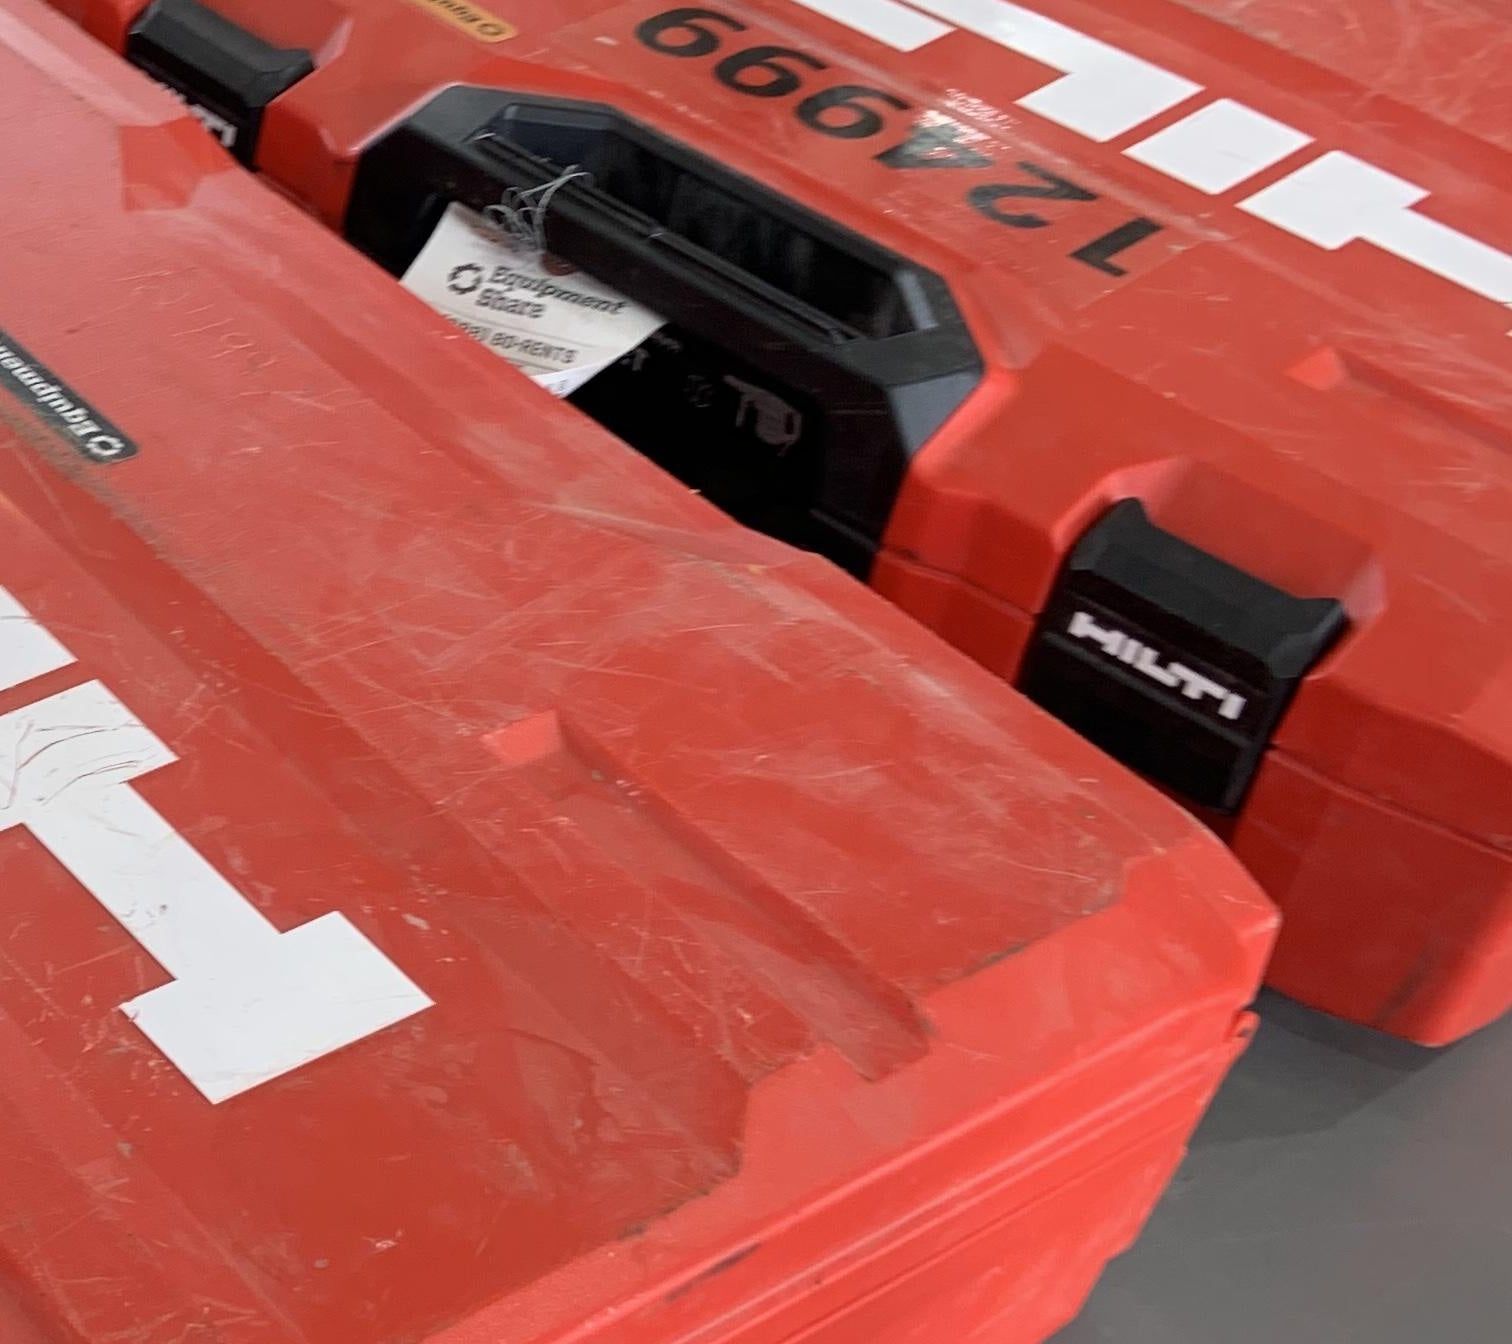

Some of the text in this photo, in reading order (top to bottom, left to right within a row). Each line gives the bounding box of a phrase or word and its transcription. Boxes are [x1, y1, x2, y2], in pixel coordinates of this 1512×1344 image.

[634, 7, 1165, 278] 124999
[474, 287, 547, 319] Share
[489, 265, 630, 316] Equipment
[1067, 611, 1247, 720] HILTI
